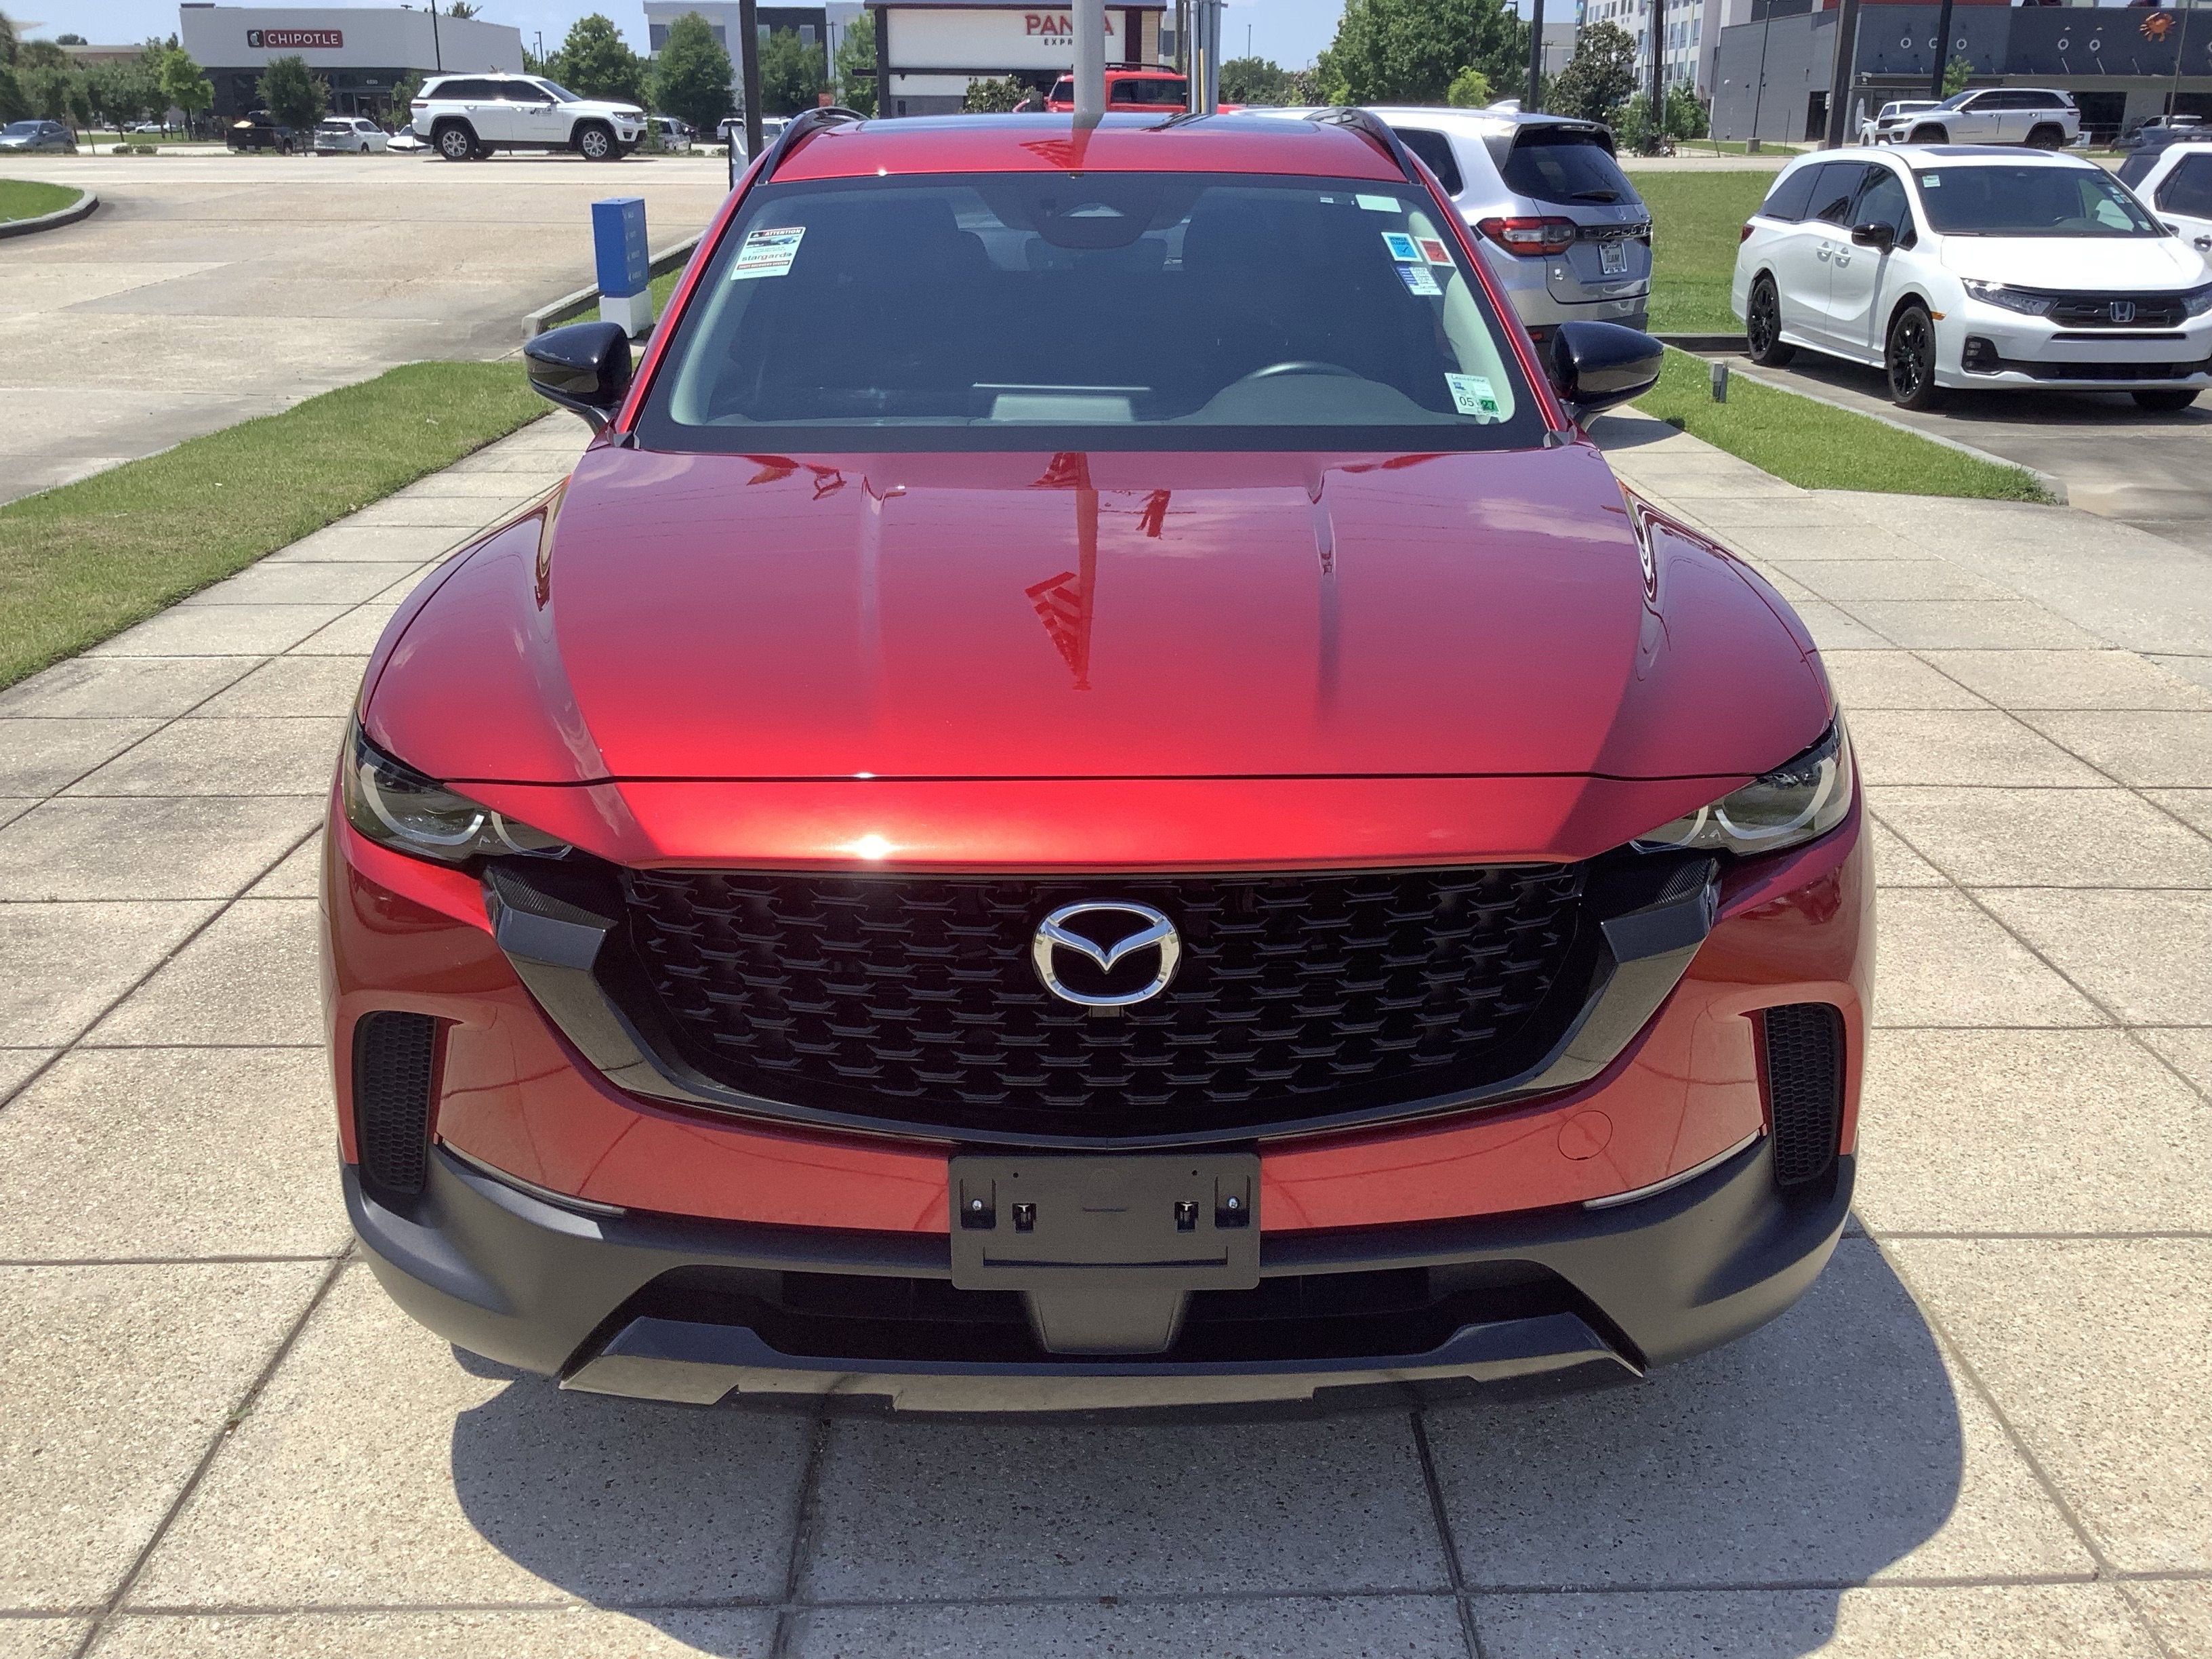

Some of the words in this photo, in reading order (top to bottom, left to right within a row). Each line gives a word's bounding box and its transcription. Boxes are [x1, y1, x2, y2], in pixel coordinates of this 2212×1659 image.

[1025, 14, 1114, 36] PANA
[267, 33, 339, 45] CHIPOTLE
[1044, 38, 1073, 46] EXPR
[1459, 396, 1474, 407] 05
[1480, 400, 1495, 411] 27
